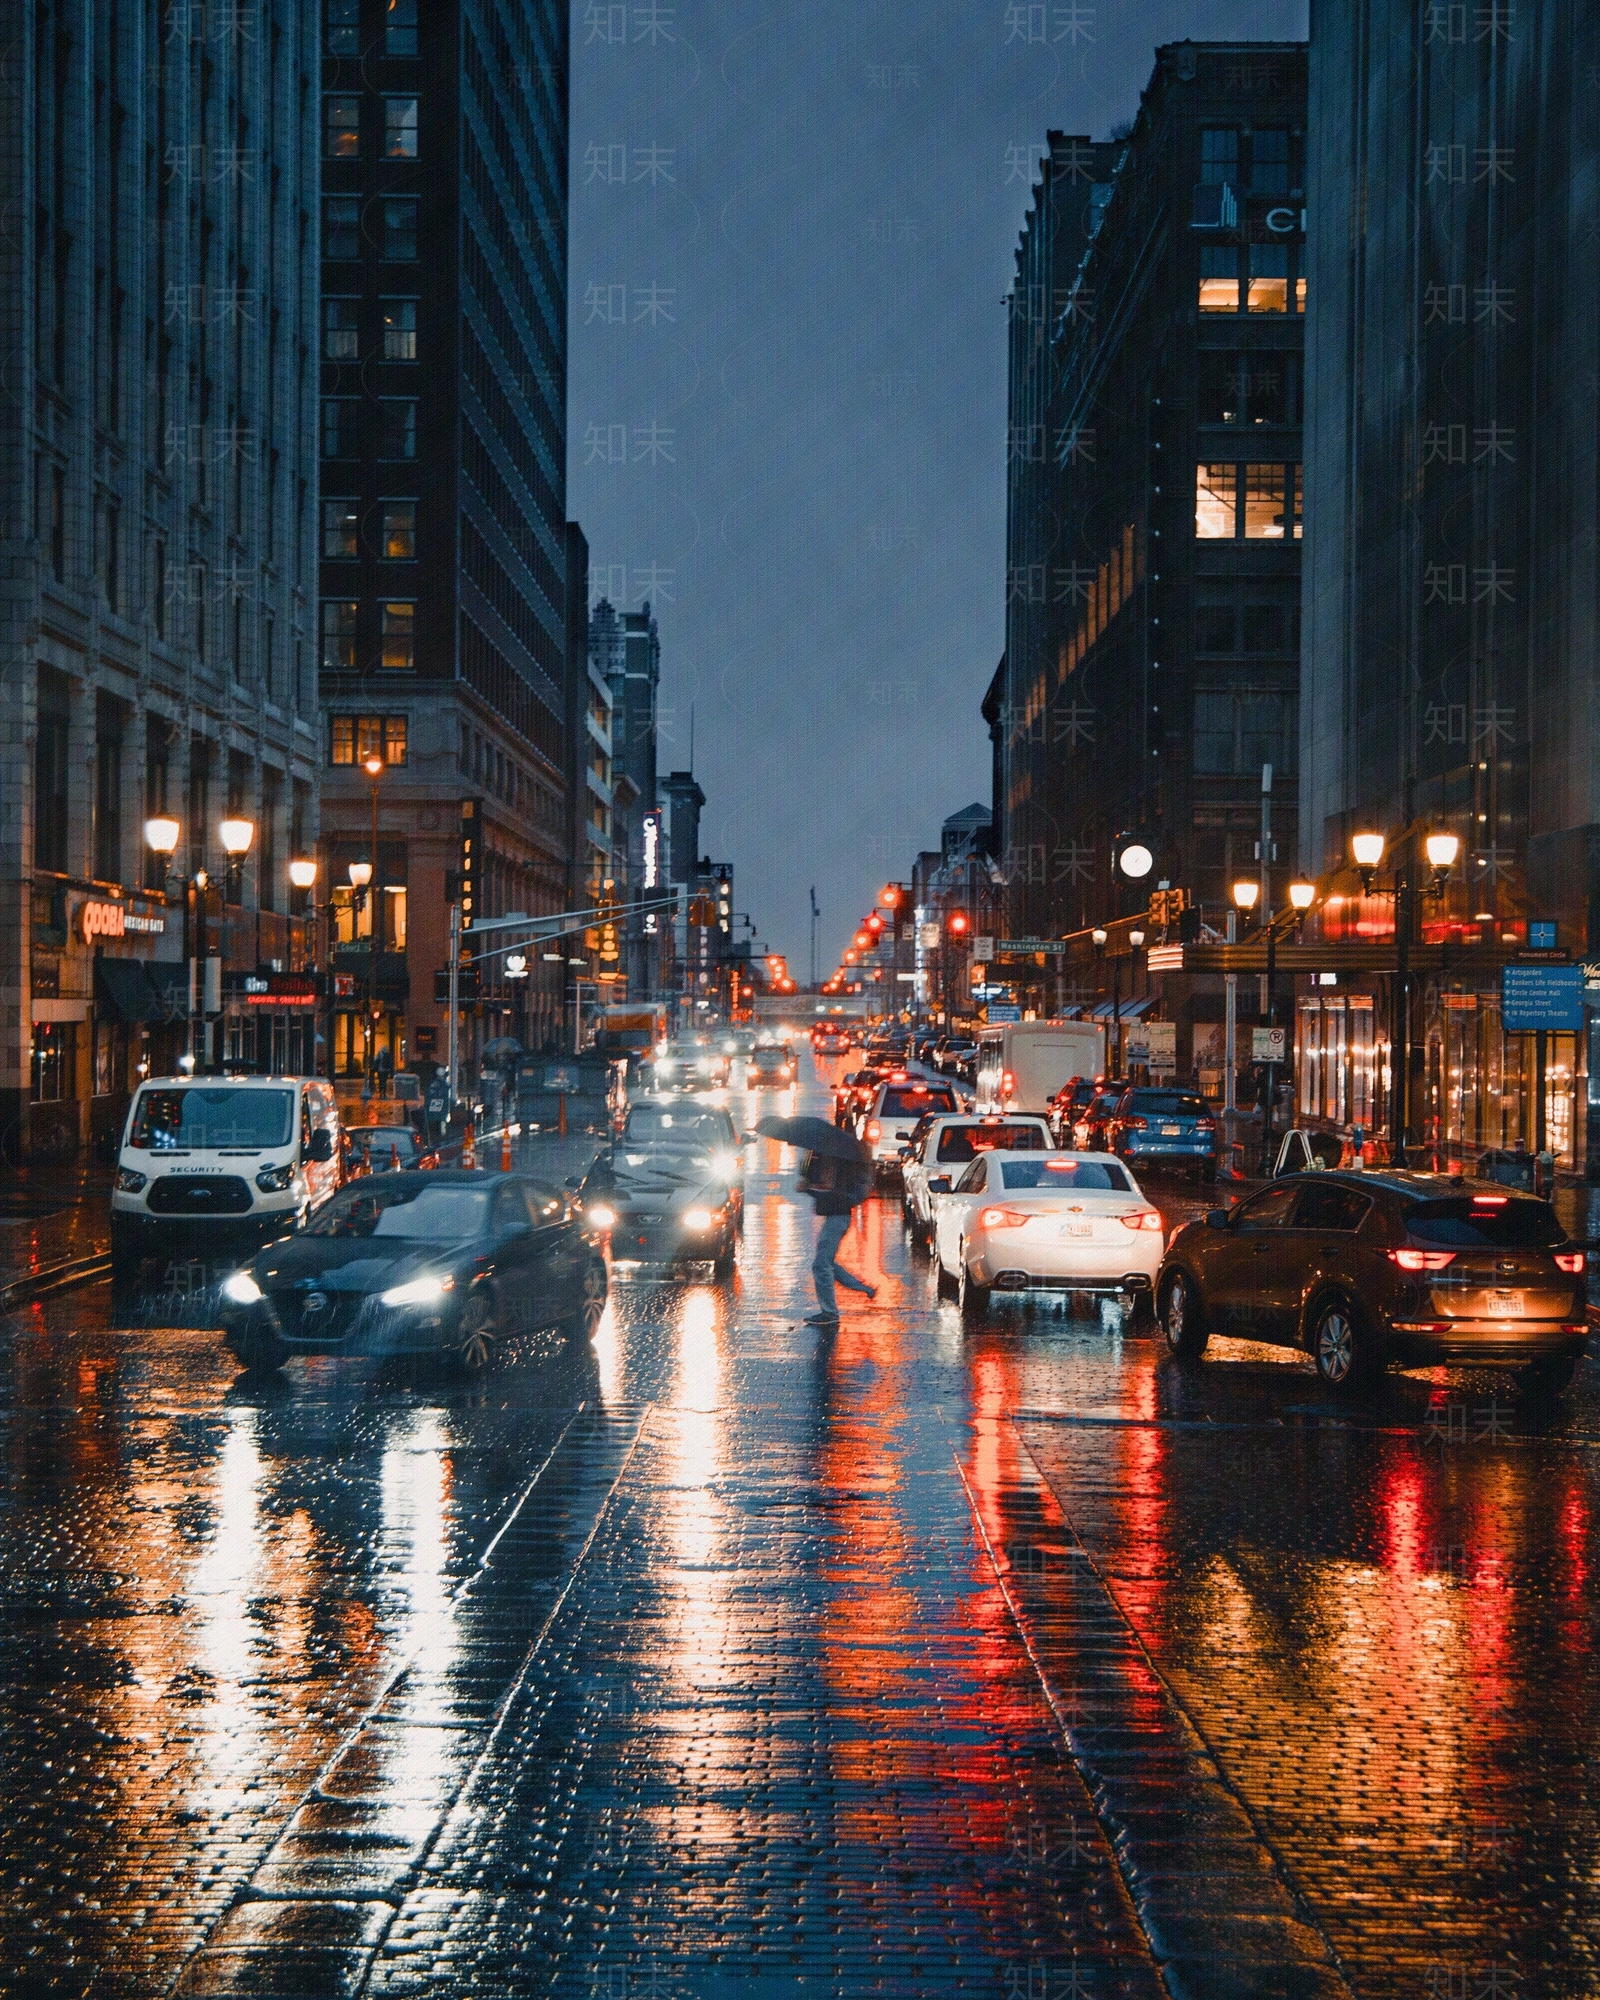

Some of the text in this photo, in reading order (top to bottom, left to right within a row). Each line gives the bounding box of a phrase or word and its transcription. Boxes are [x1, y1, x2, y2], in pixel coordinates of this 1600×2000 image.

[83, 901, 125, 945] QDOBA
[125, 915, 149, 931] MEXICAN
[1001, 942, 1063, 951] Washington St
[1512, 969, 1542, 977] Artsgarden
